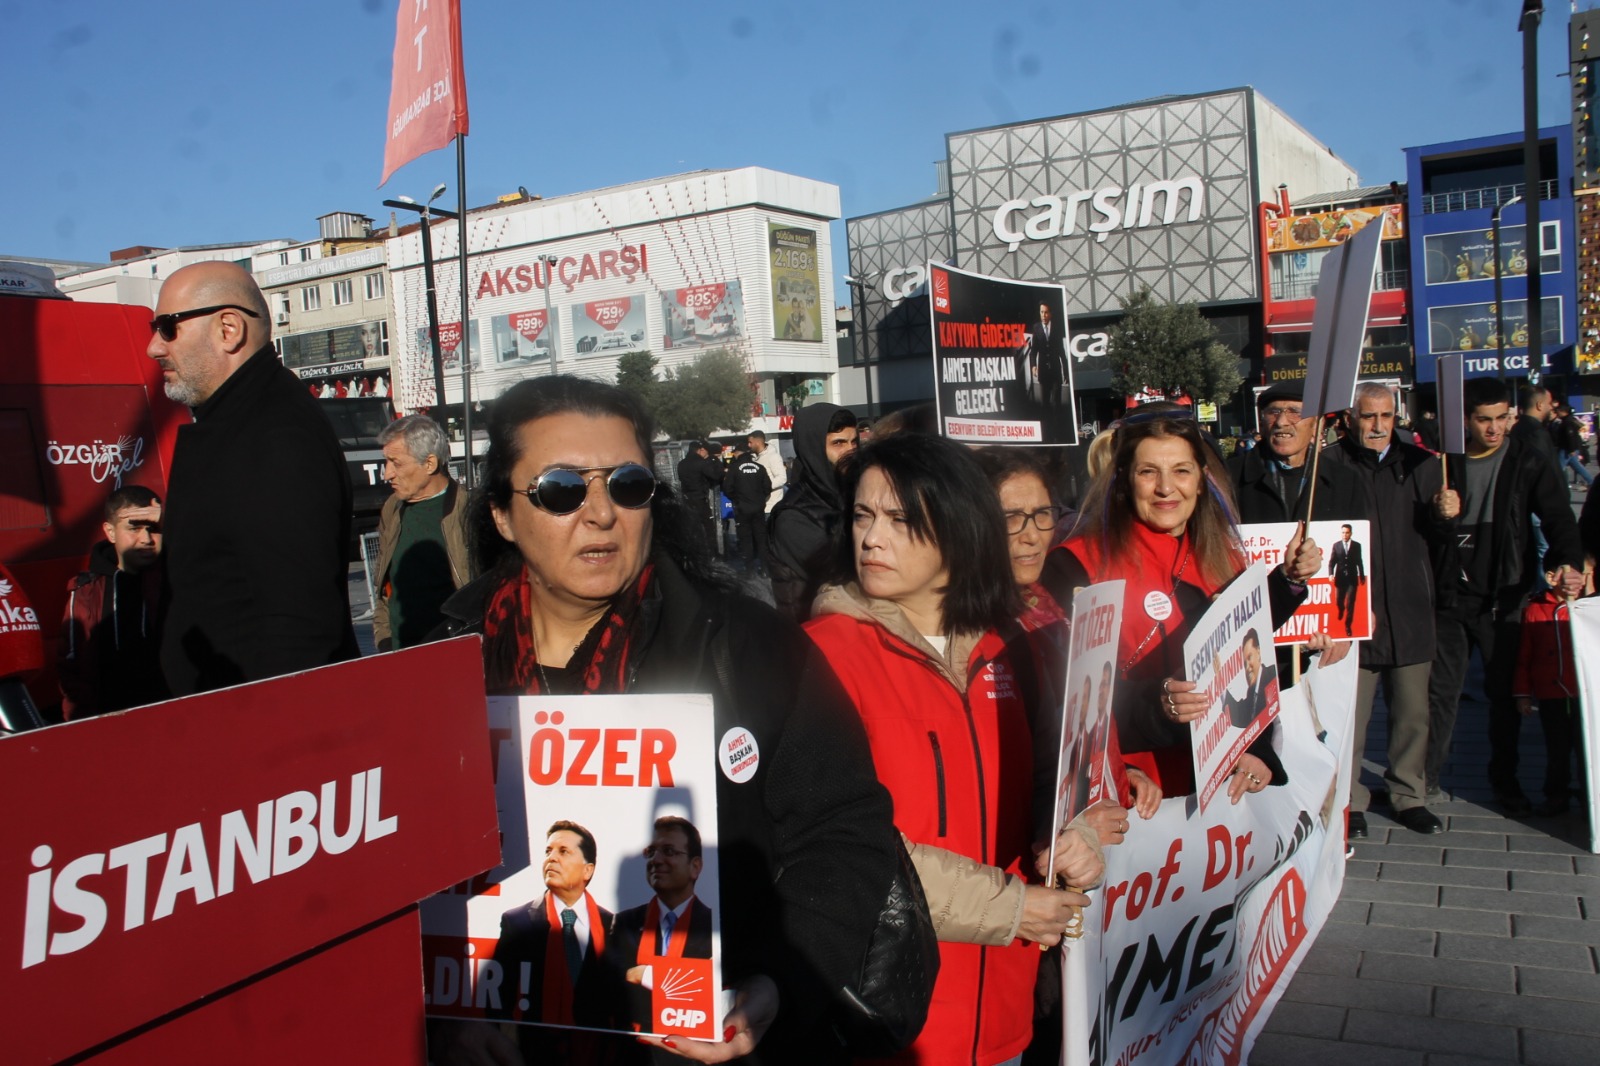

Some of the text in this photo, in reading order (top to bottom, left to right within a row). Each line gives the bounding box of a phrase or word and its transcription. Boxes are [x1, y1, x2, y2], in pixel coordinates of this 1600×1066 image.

[477, 243, 648, 299] AKSU ÇARŞI
[939, 316, 1026, 348] KAYYUM GİDECEK
[942, 356, 1016, 387] AHMET BAŞKAN
[1465, 353, 1554, 372] TURKCEL
[955, 388, 998, 415] GELECEK
[948, 421, 1035, 440] ESENYURT BELEDİYE BAŞKANI
[1260, 537, 1274, 547] Dr.
[12, 623, 40, 632] AJANSI
[1085, 596, 1116, 652] ÖZER
[1191, 585, 1262, 683] ESENYURT HALKI
[528, 710, 678, 788] ÖZER
[728, 733, 747, 752] AHMET
[1196, 703, 1232, 773] YANINDA
[729, 743, 753, 765] BAŞKAN
[21, 766, 398, 970] İSTANBUL
[1101, 838, 1185, 934] rof.
[1202, 824, 1255, 893] Dr.
[424, 942, 504, 1010] DİR
[660, 1007, 707, 1029] CHP
